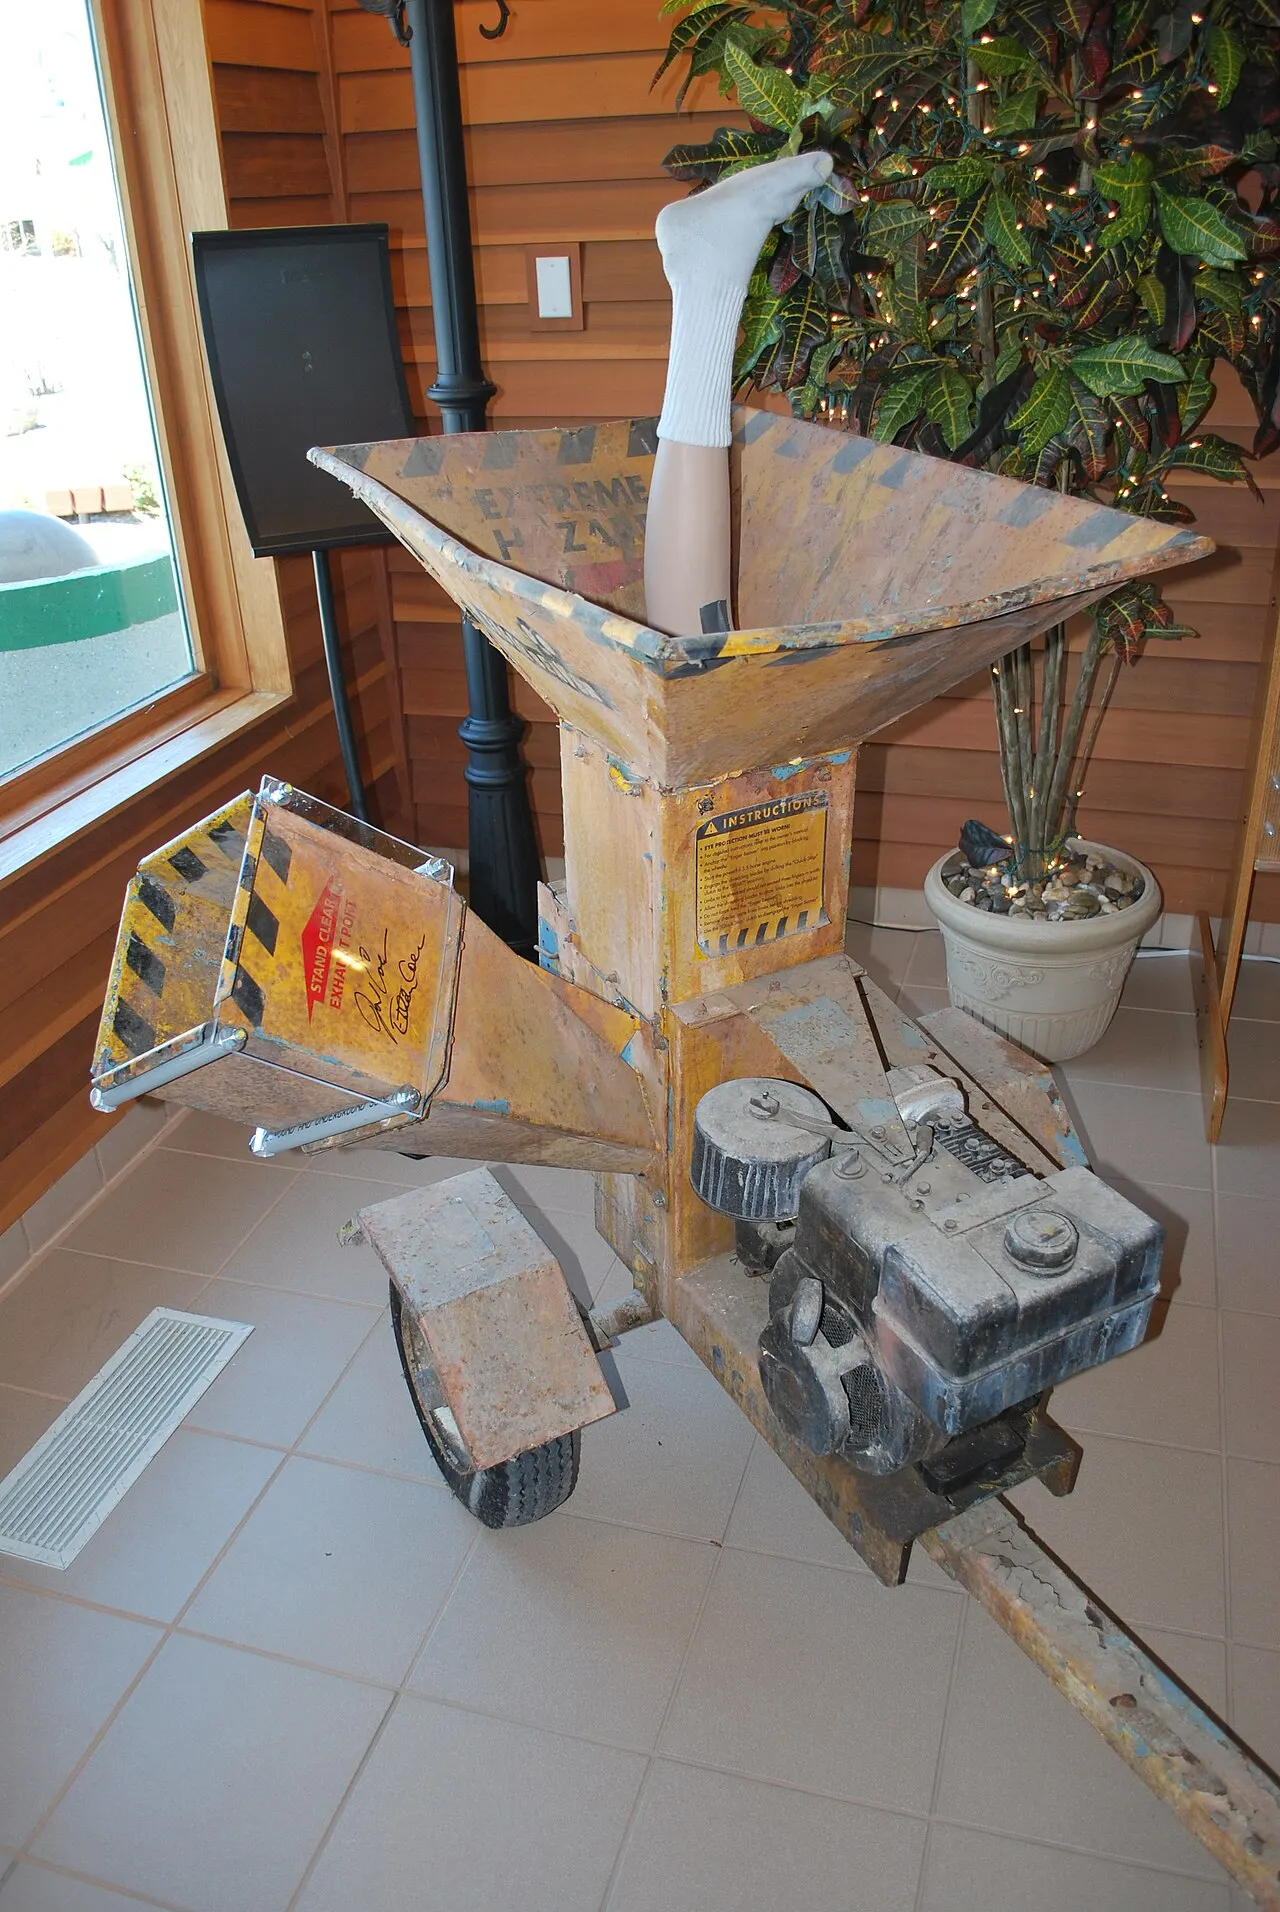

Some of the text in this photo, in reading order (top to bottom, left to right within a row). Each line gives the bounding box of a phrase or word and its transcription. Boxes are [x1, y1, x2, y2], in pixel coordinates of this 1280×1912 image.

[722, 797, 820, 829] INSTRUCTIONS
[715, 834, 747, 847] PROTECTION
[748, 830, 762, 838] MUST
[318, 897, 336, 942] CLEAR
[310, 945, 328, 993] STAND
[330, 898, 357, 1009] EXHAT PORT
